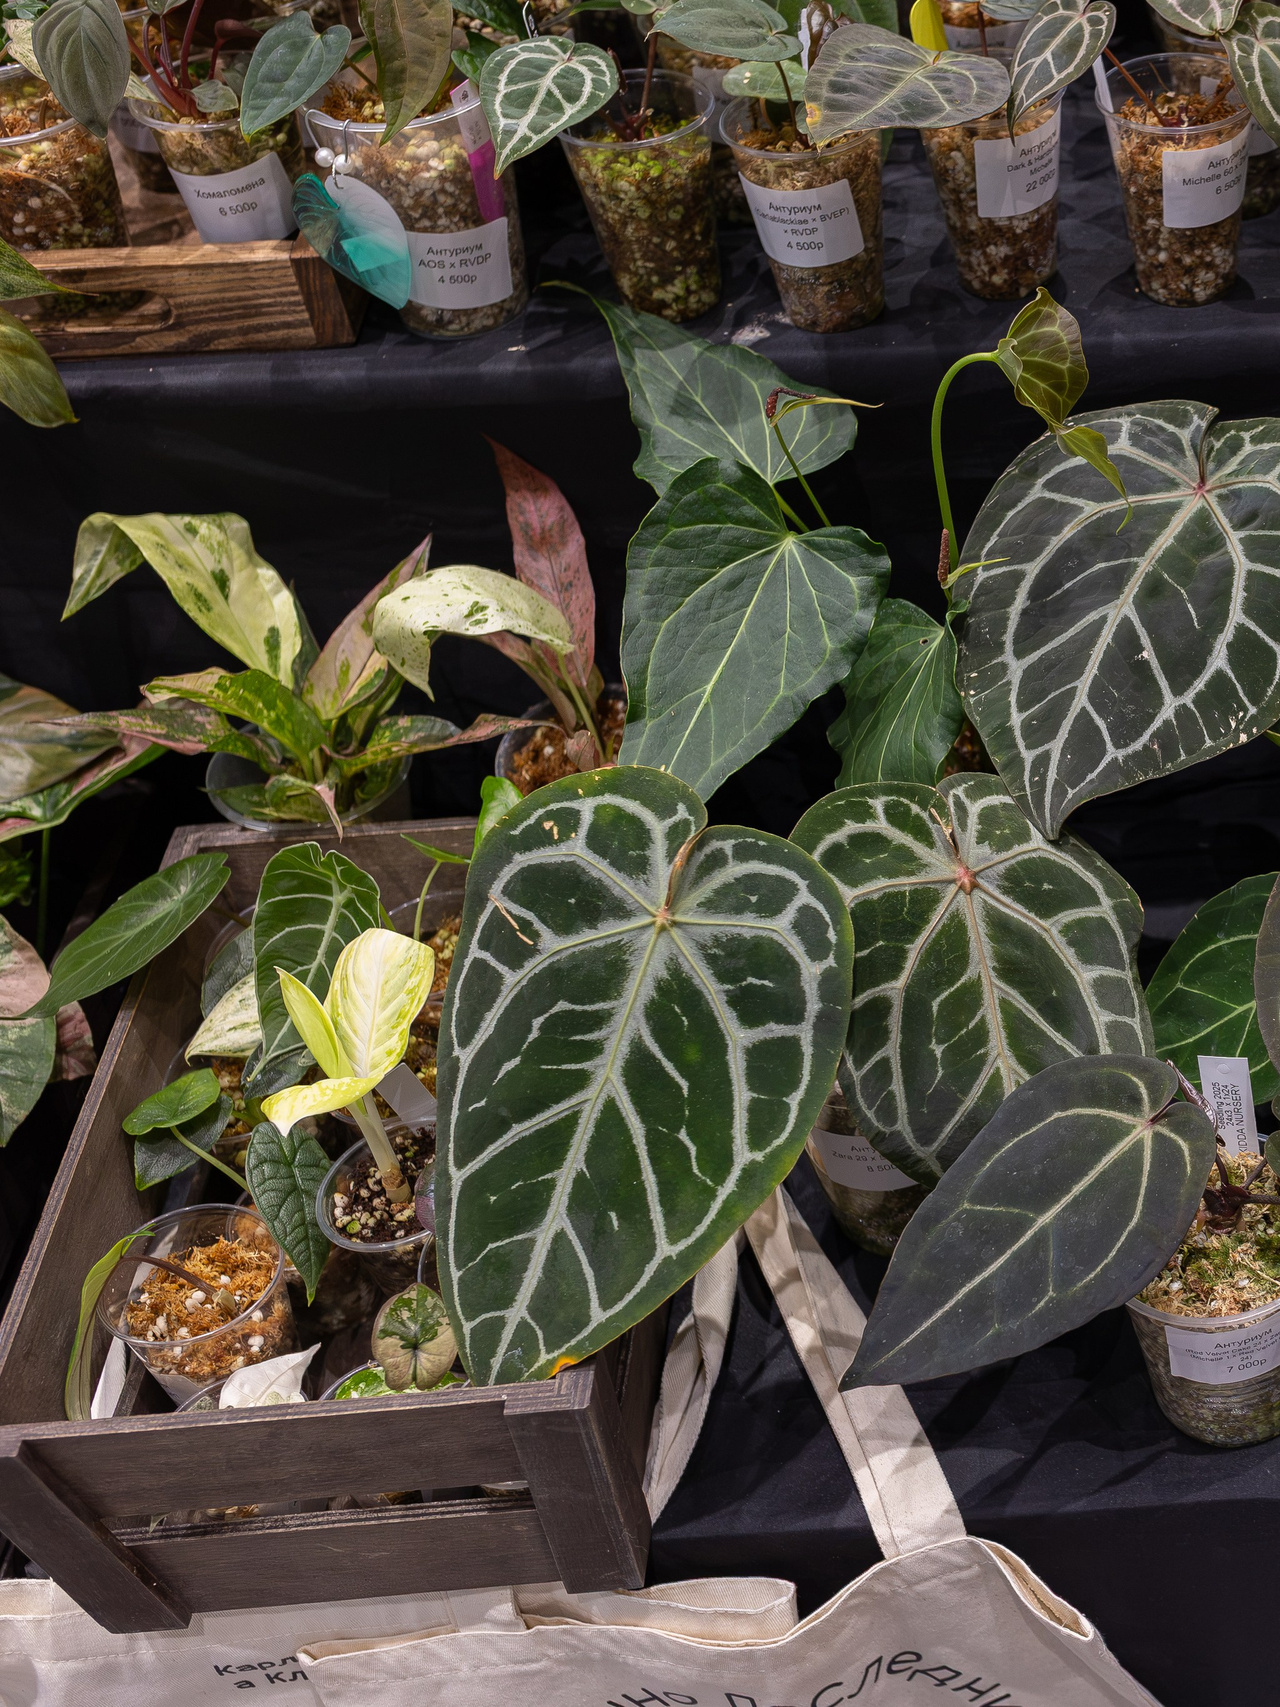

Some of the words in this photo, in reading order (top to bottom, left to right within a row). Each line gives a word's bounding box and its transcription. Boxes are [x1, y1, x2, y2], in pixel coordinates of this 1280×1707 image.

[1006, 162, 1026, 173] Dark
[1182, 173, 1222, 186] Michelle
[1223, 166, 1234, 177] 60
[194, 177, 266, 200] Хомаломена
[1025, 180, 1038, 193] 22
[1215, 185, 1222, 195] 6
[229, 201, 258, 215] 500р
[768, 201, 822, 216] Антуриум
[820, 206, 850, 223] BVEP)
[791, 227, 819, 237] RVDP
[426, 242, 484, 258] Антуриум
[786, 241, 793, 250] 4
[796, 240, 824, 251] 500р
[418, 259, 446, 270] AOS
[459, 252, 492, 268] RVDP
[438, 275, 445, 284] 4
[1212, 1081, 1222, 1100] 2025
[1230, 1083, 1245, 1127] NURSERY
[831, 1150, 853, 1161] Zara
[1214, 1328, 1273, 1350] Антуриум
[1237, 1358, 1267, 1371] 000р
